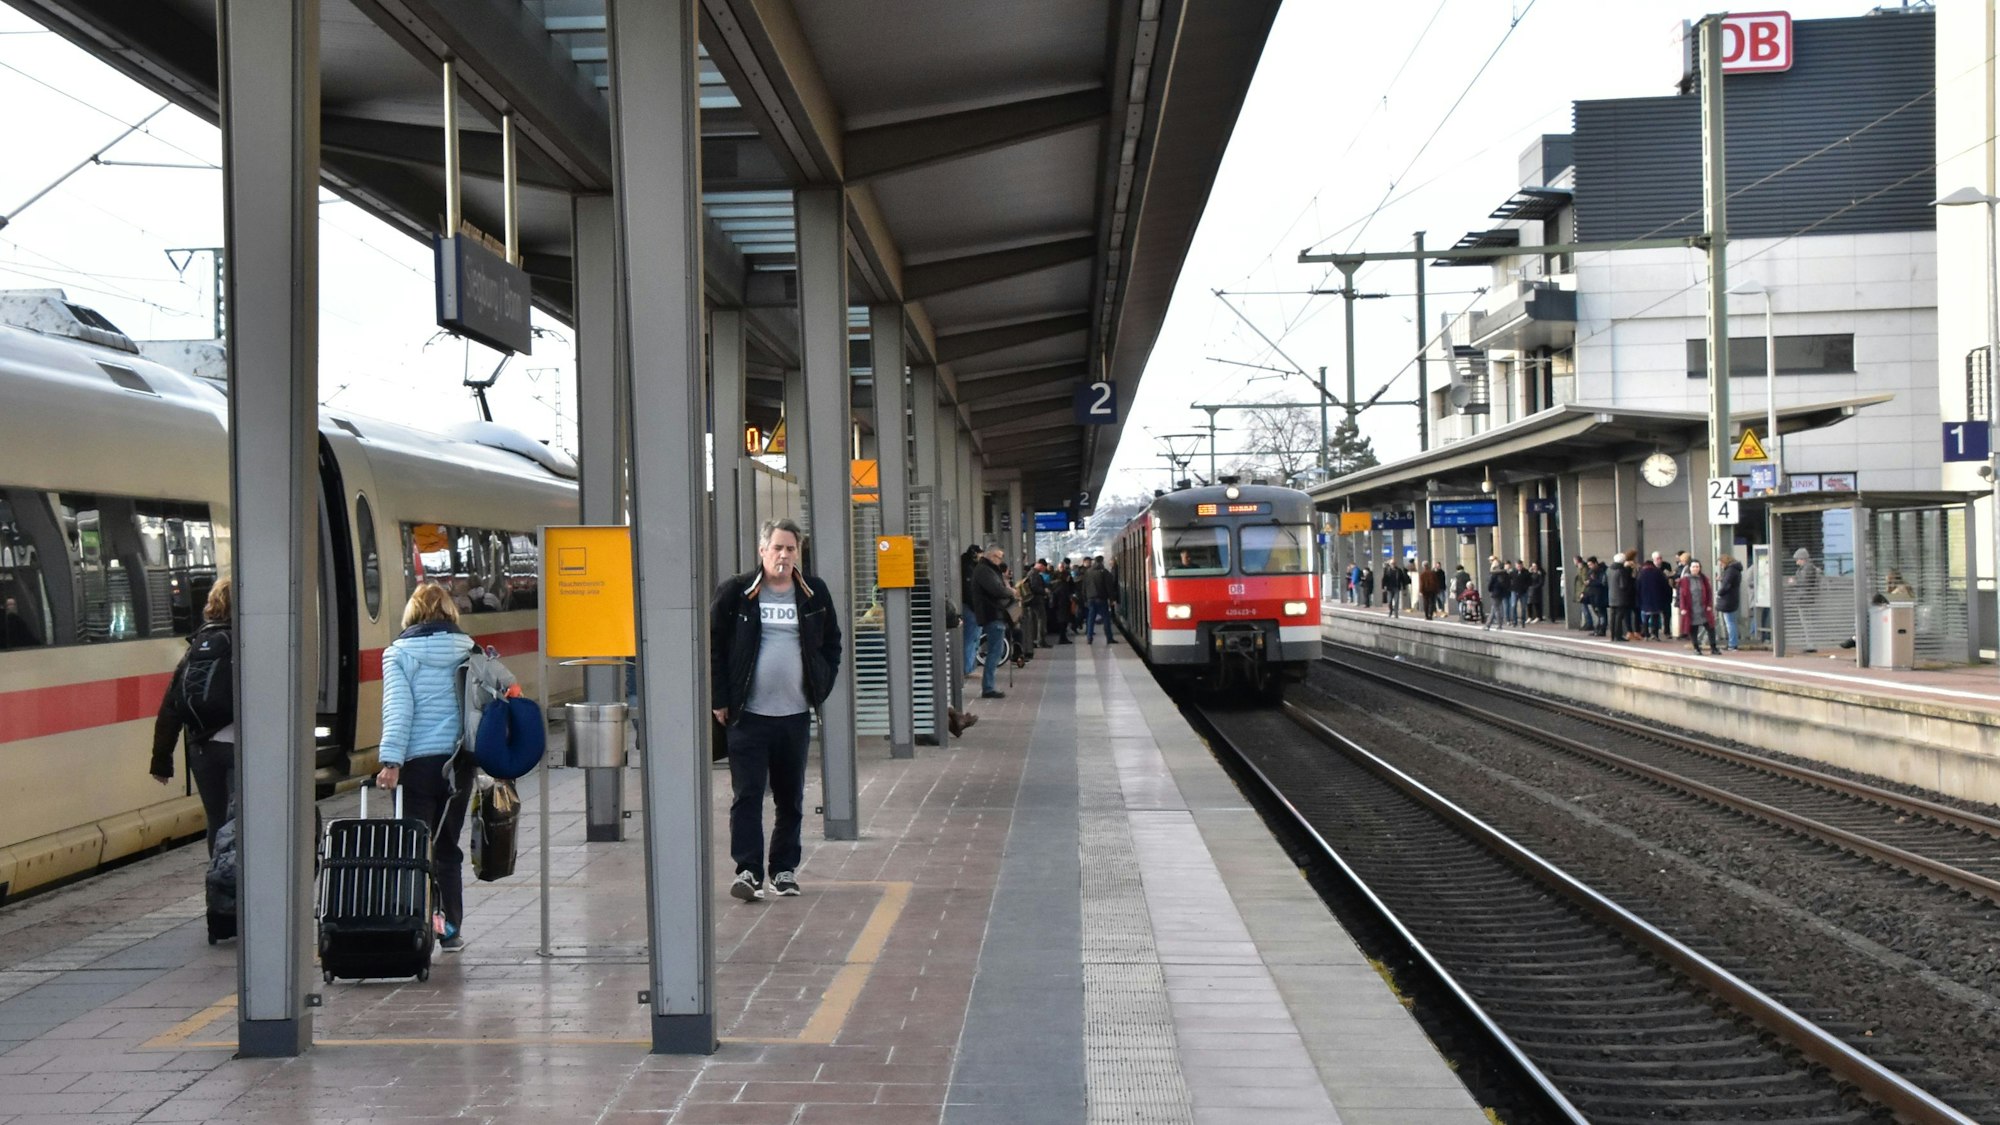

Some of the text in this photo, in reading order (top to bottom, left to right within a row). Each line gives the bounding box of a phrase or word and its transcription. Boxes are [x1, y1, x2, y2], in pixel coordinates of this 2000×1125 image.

[1722, 21, 1780, 62] DB
[1090, 382, 1112, 415] 2
[1950, 425, 1965, 455] 1
[1079, 491, 1089, 506] 2
[1710, 480, 1736, 499] 24
[1717, 501, 1730, 519] 4
[1230, 585, 1243, 593] DB
[777, 607, 796, 620] DO
